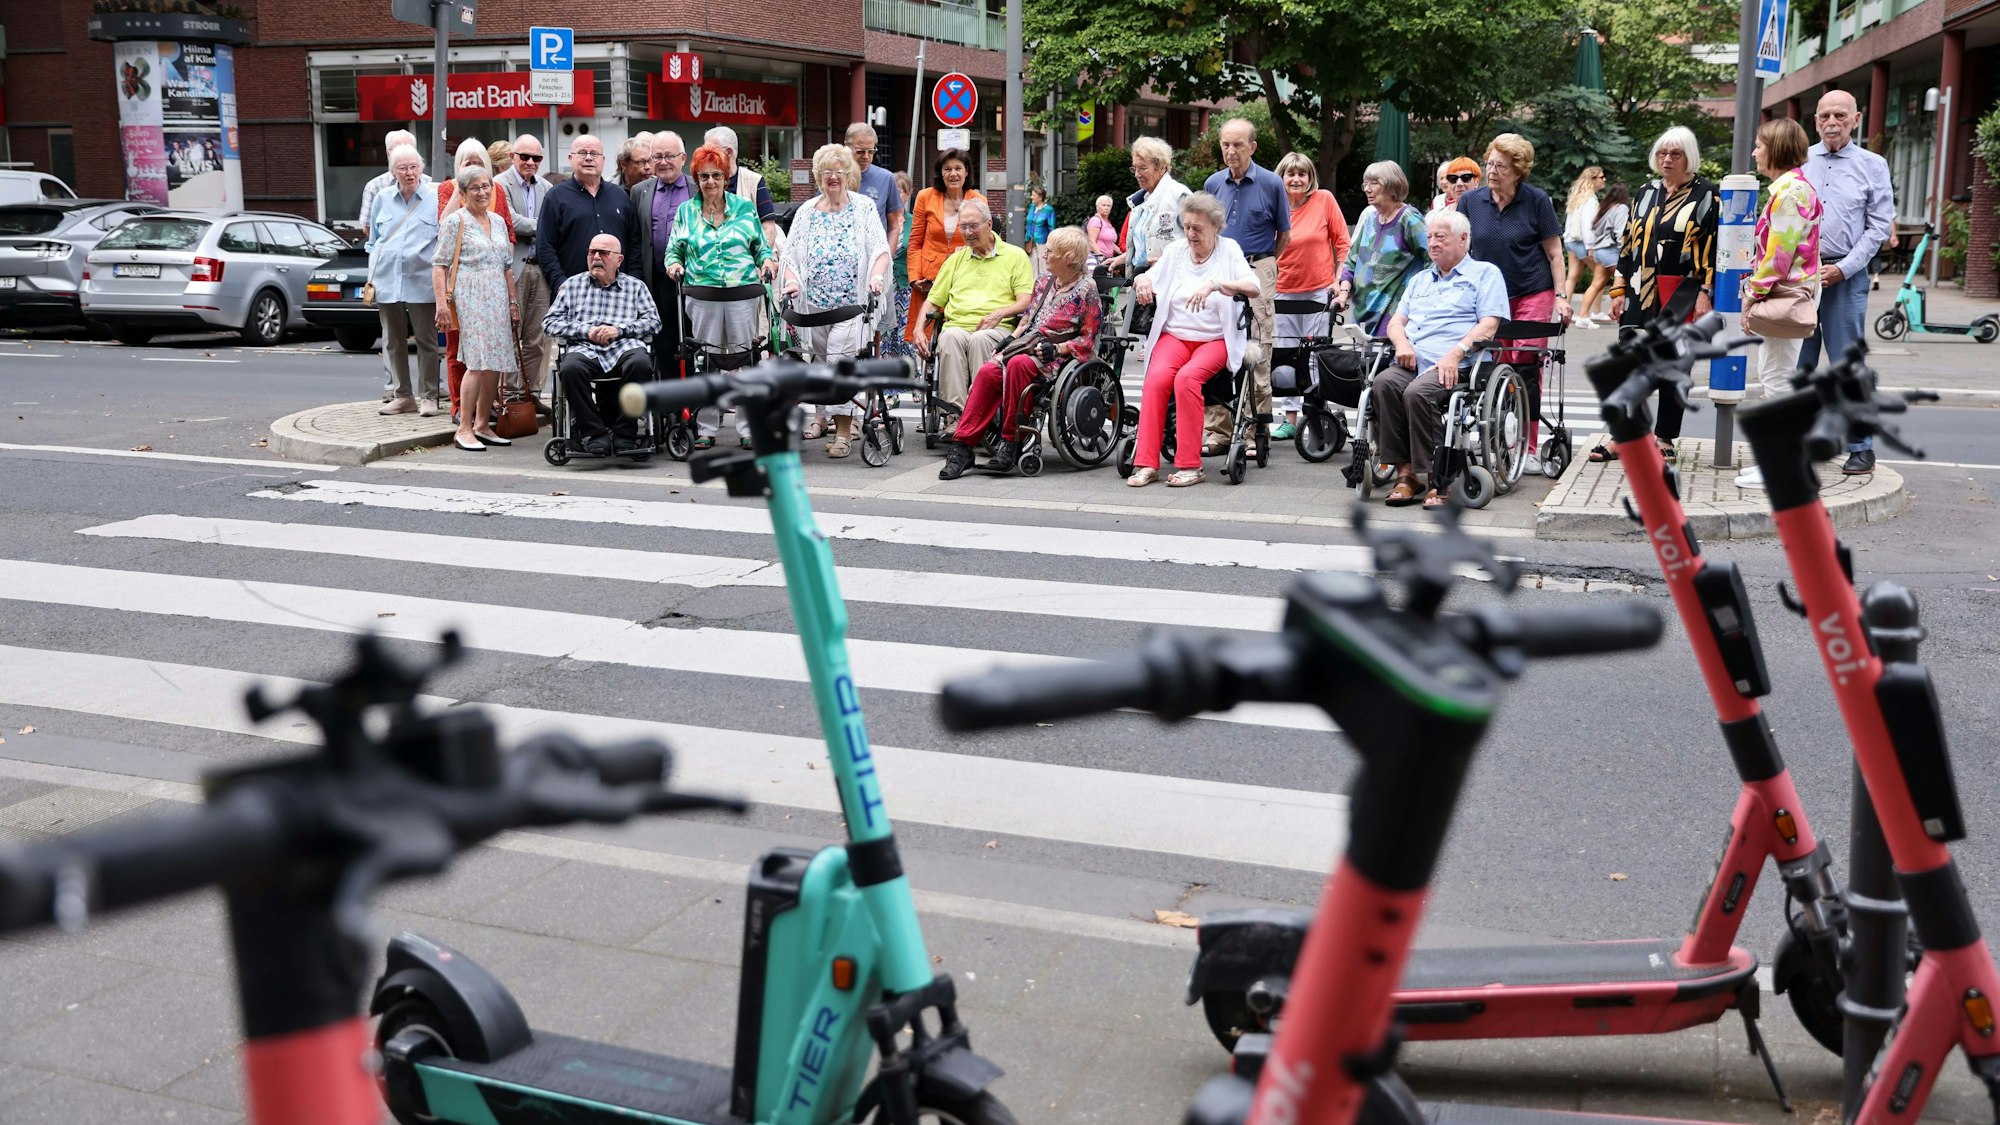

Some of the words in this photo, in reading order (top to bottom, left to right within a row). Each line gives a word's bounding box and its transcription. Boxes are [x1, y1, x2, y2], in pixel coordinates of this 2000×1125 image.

[183, 20, 221, 32] STRÖER
[183, 44, 212, 54] Hilma
[184, 54, 194, 63] af
[195, 54, 217, 65] Klint
[540, 33, 563, 65] P
[167, 88, 219, 100] Kandinsky
[433, 86, 485, 109] iraat
[487, 84, 533, 108] Bank
[704, 90, 738, 114] Ziraat
[738, 93, 767, 115] Bank
[179, 160, 214, 173] ELVIS
[1654, 523, 1691, 580] voi.
[1819, 612, 1867, 685] voi.
[834, 675, 882, 829] TIER
[788, 1006, 841, 1111] TIER
